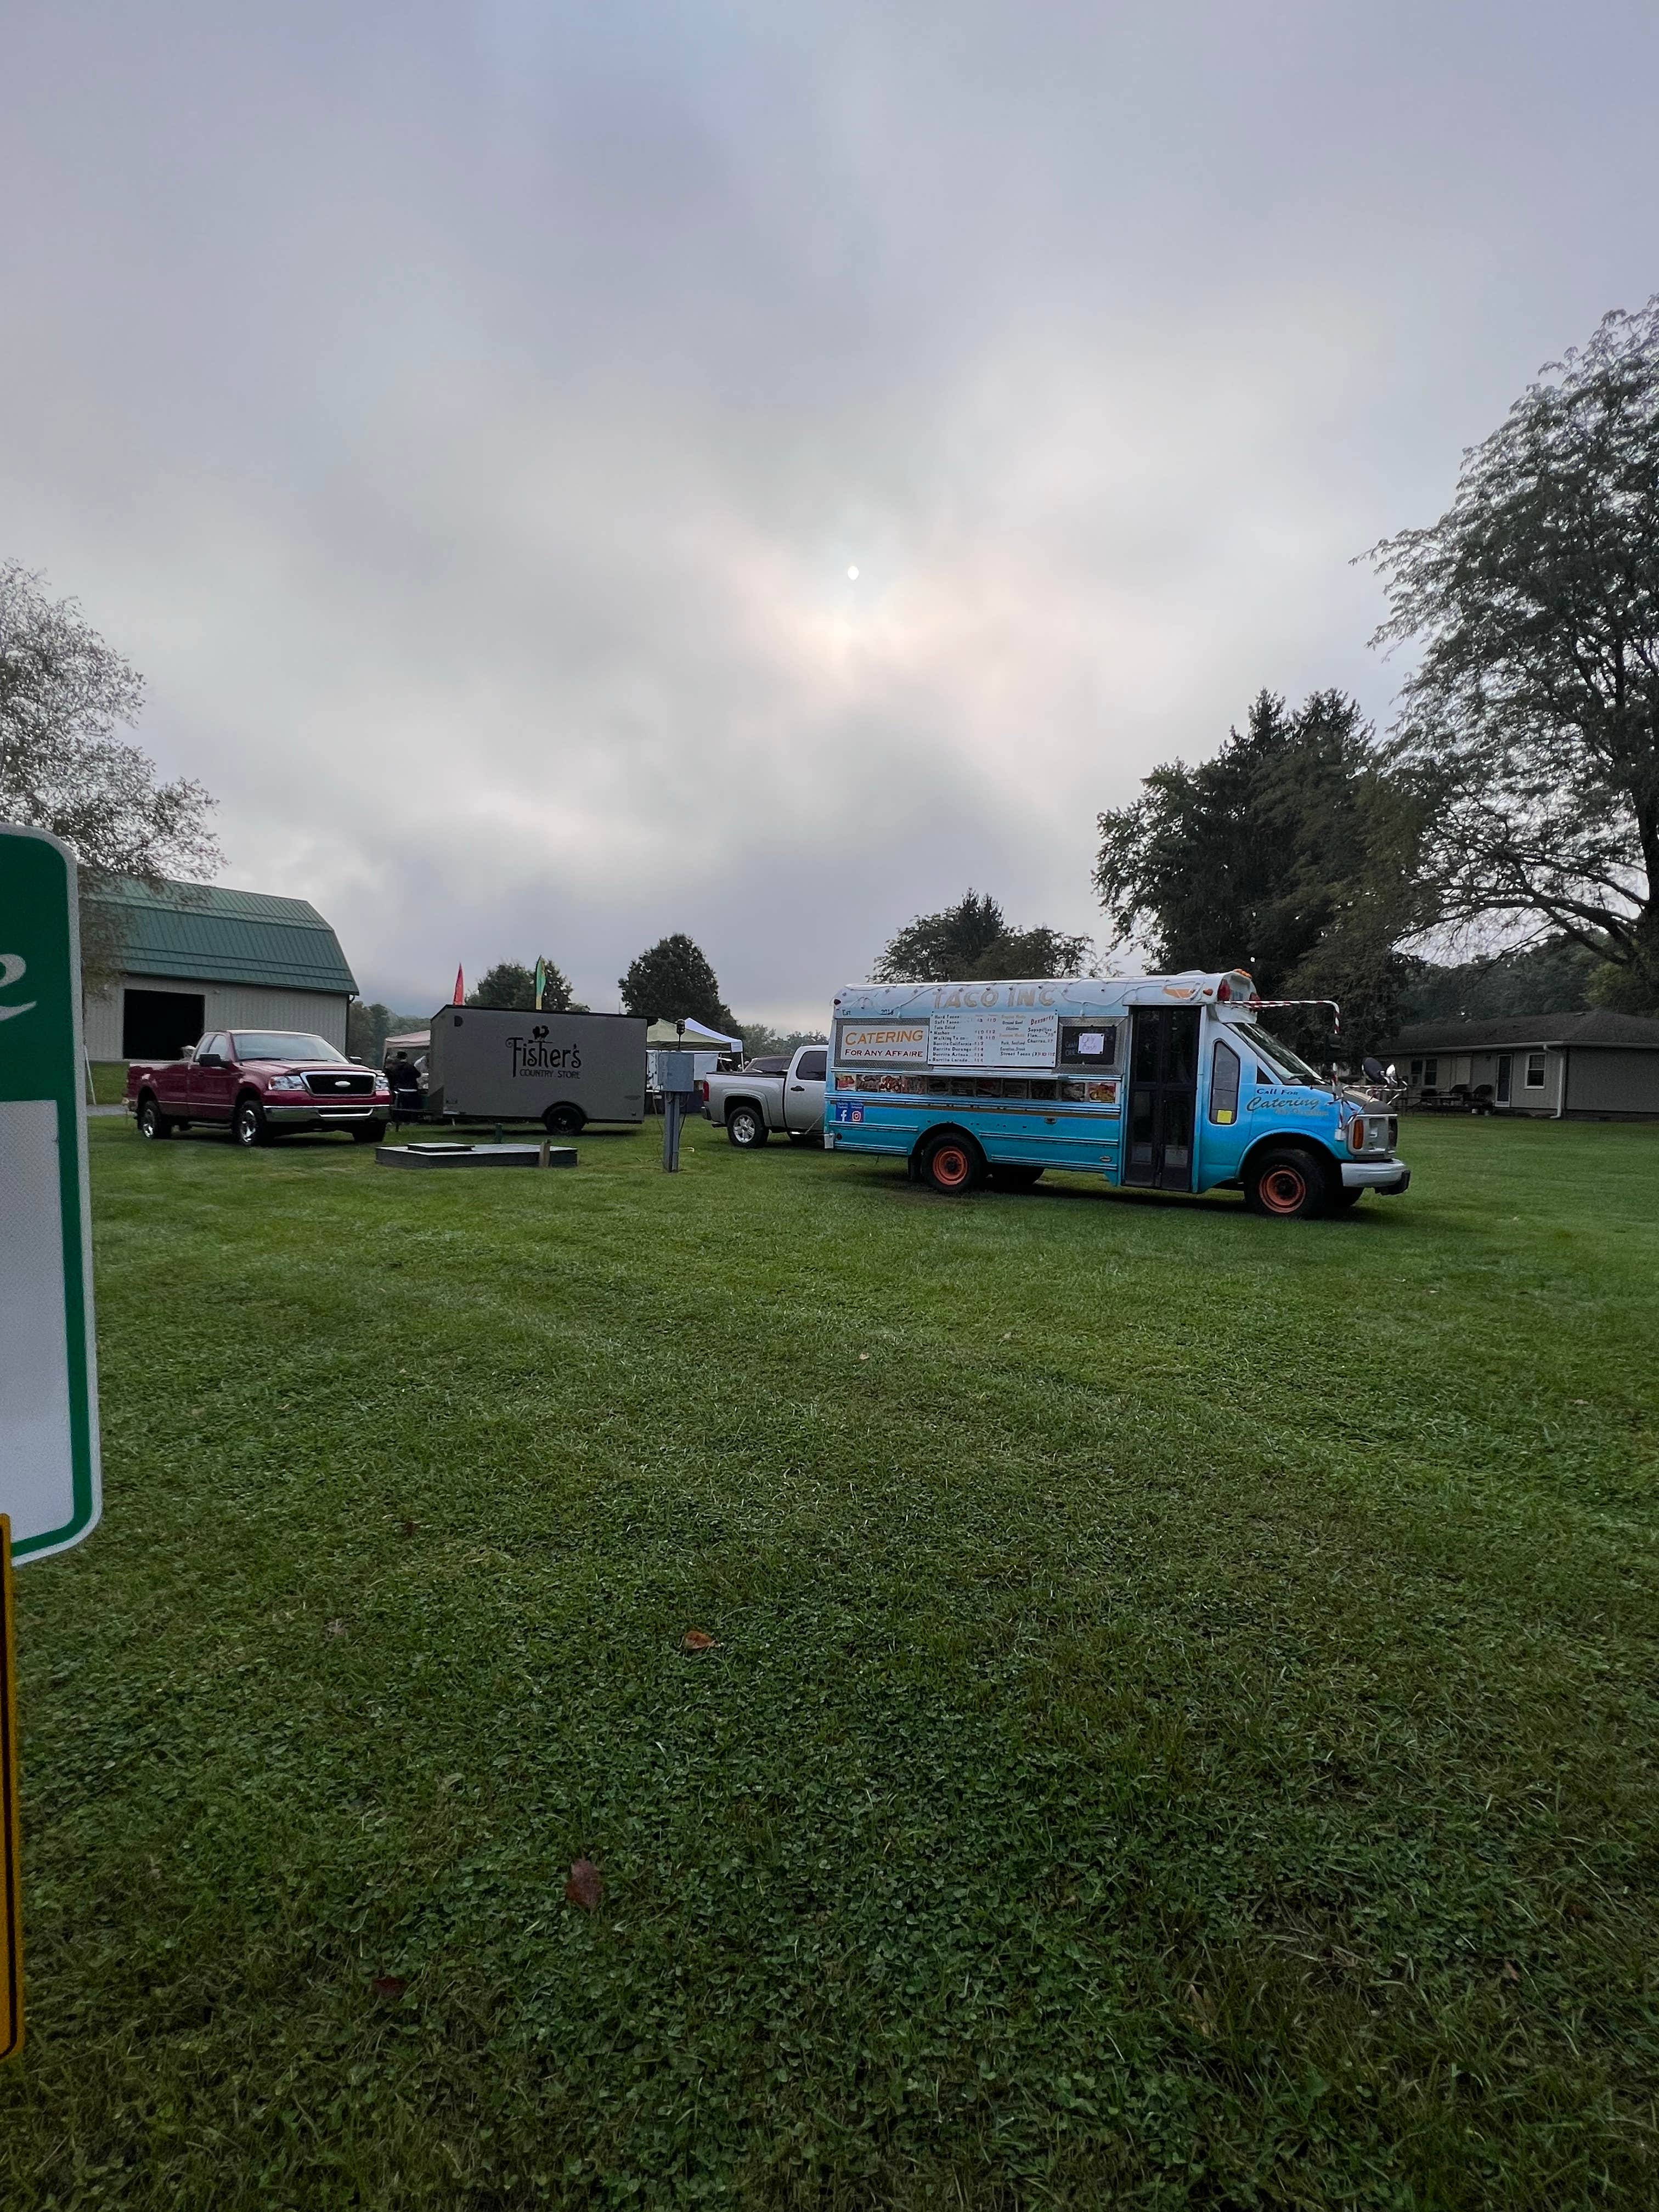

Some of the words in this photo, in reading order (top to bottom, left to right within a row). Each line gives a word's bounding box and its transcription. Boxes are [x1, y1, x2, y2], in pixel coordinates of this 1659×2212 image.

[933, 990, 999, 1009] TACO
[845, 1030, 923, 1045] CATERING
[505, 1037, 582, 1077] Fisher's
[519, 1069, 554, 1077] COUNTRY
[557, 1070, 580, 1079] STORE
[1246, 1096, 1320, 1111] Catering
